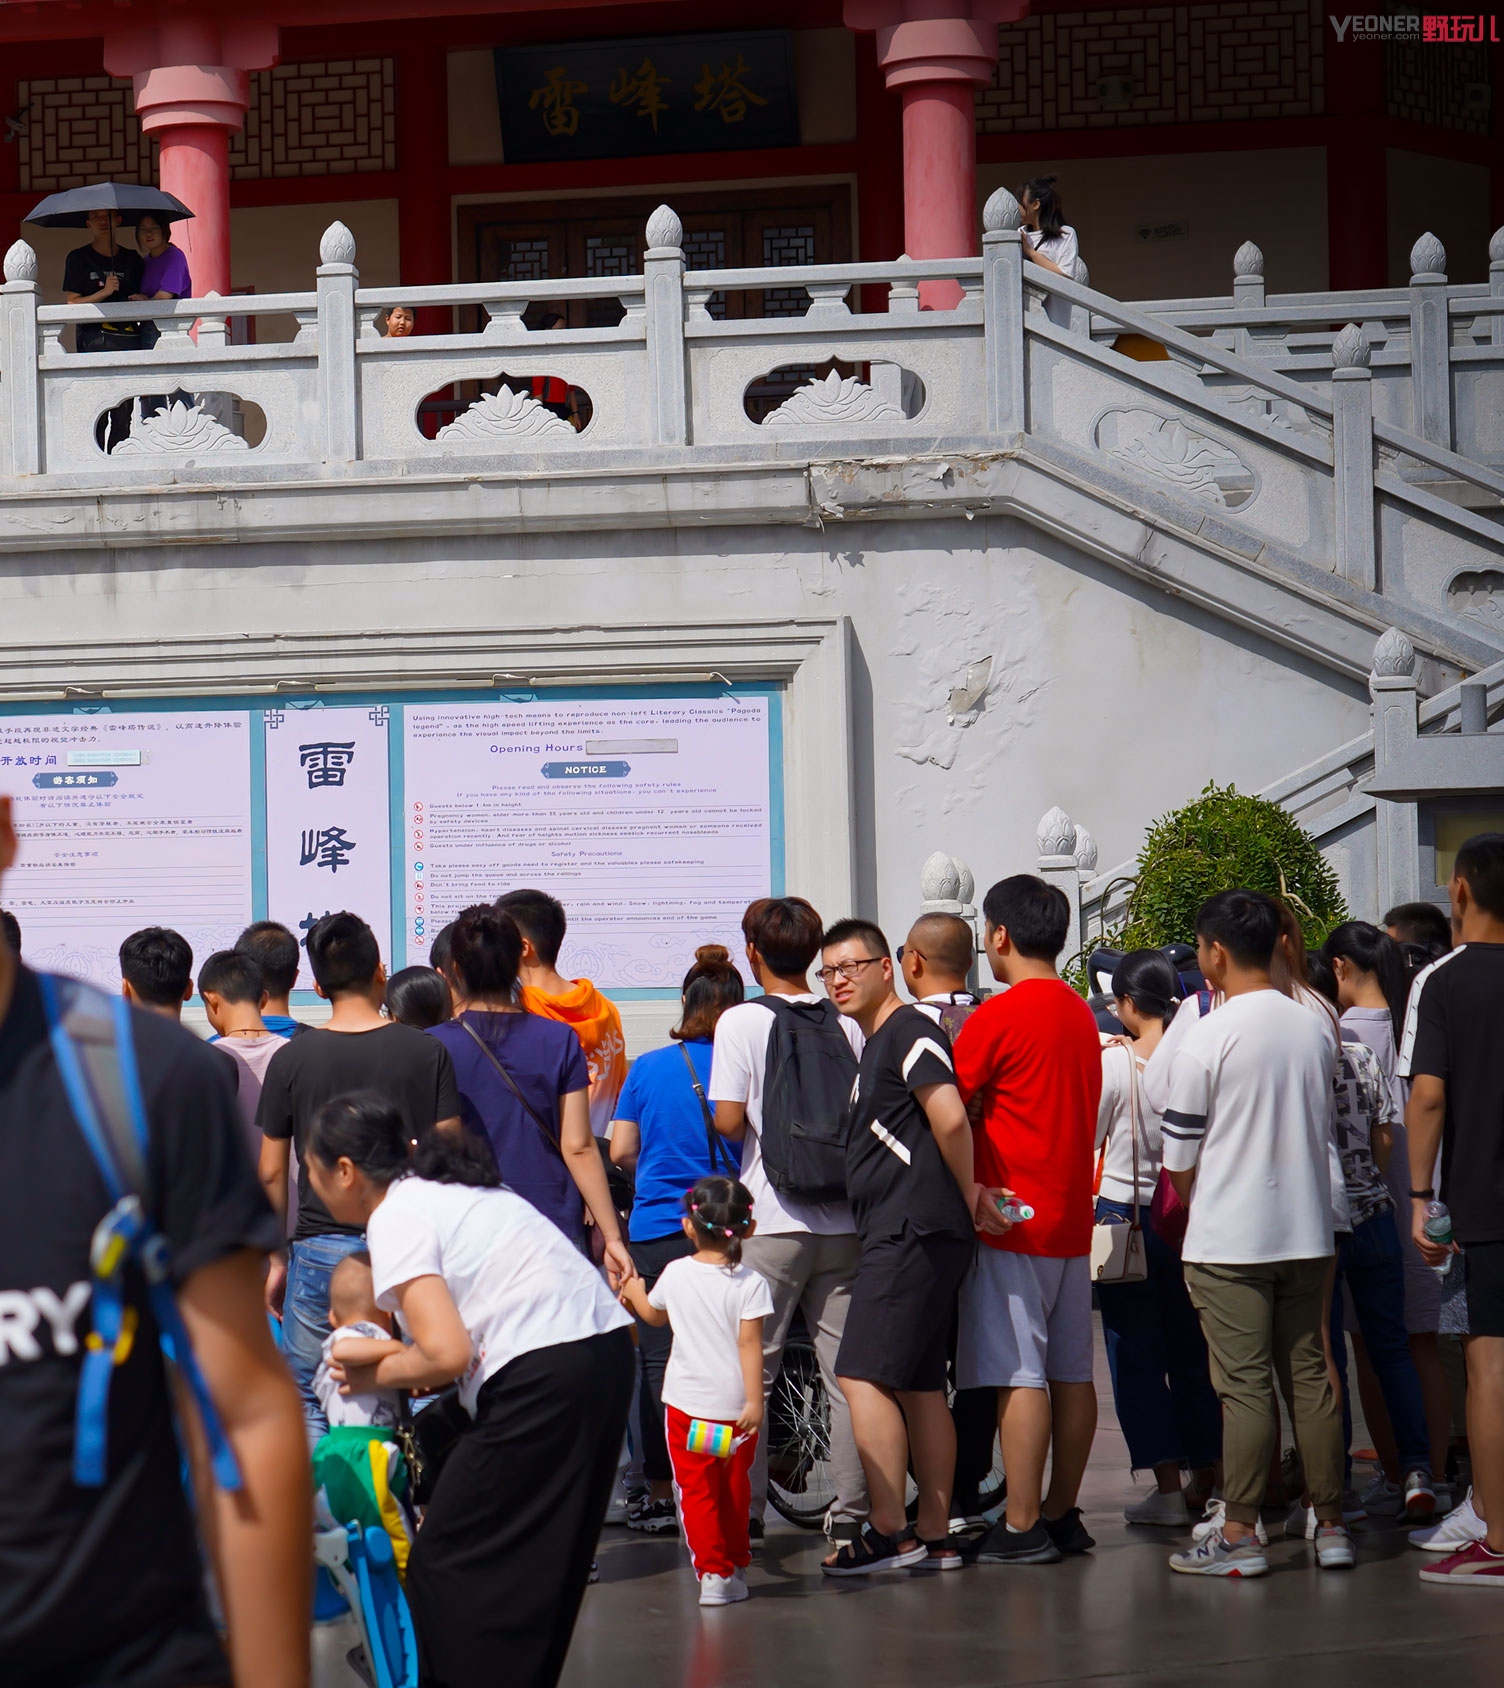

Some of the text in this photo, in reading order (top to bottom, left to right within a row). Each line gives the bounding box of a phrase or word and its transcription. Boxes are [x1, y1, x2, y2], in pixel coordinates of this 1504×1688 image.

[528, 54, 769, 136] 雷峰塔
[490, 744, 540, 753] Opening
[0, 755, 56, 766] 开放时间
[564, 766, 607, 774] NOTICE
[52, 776, 98, 785] 游客须知
[299, 741, 356, 947] 雷峰
